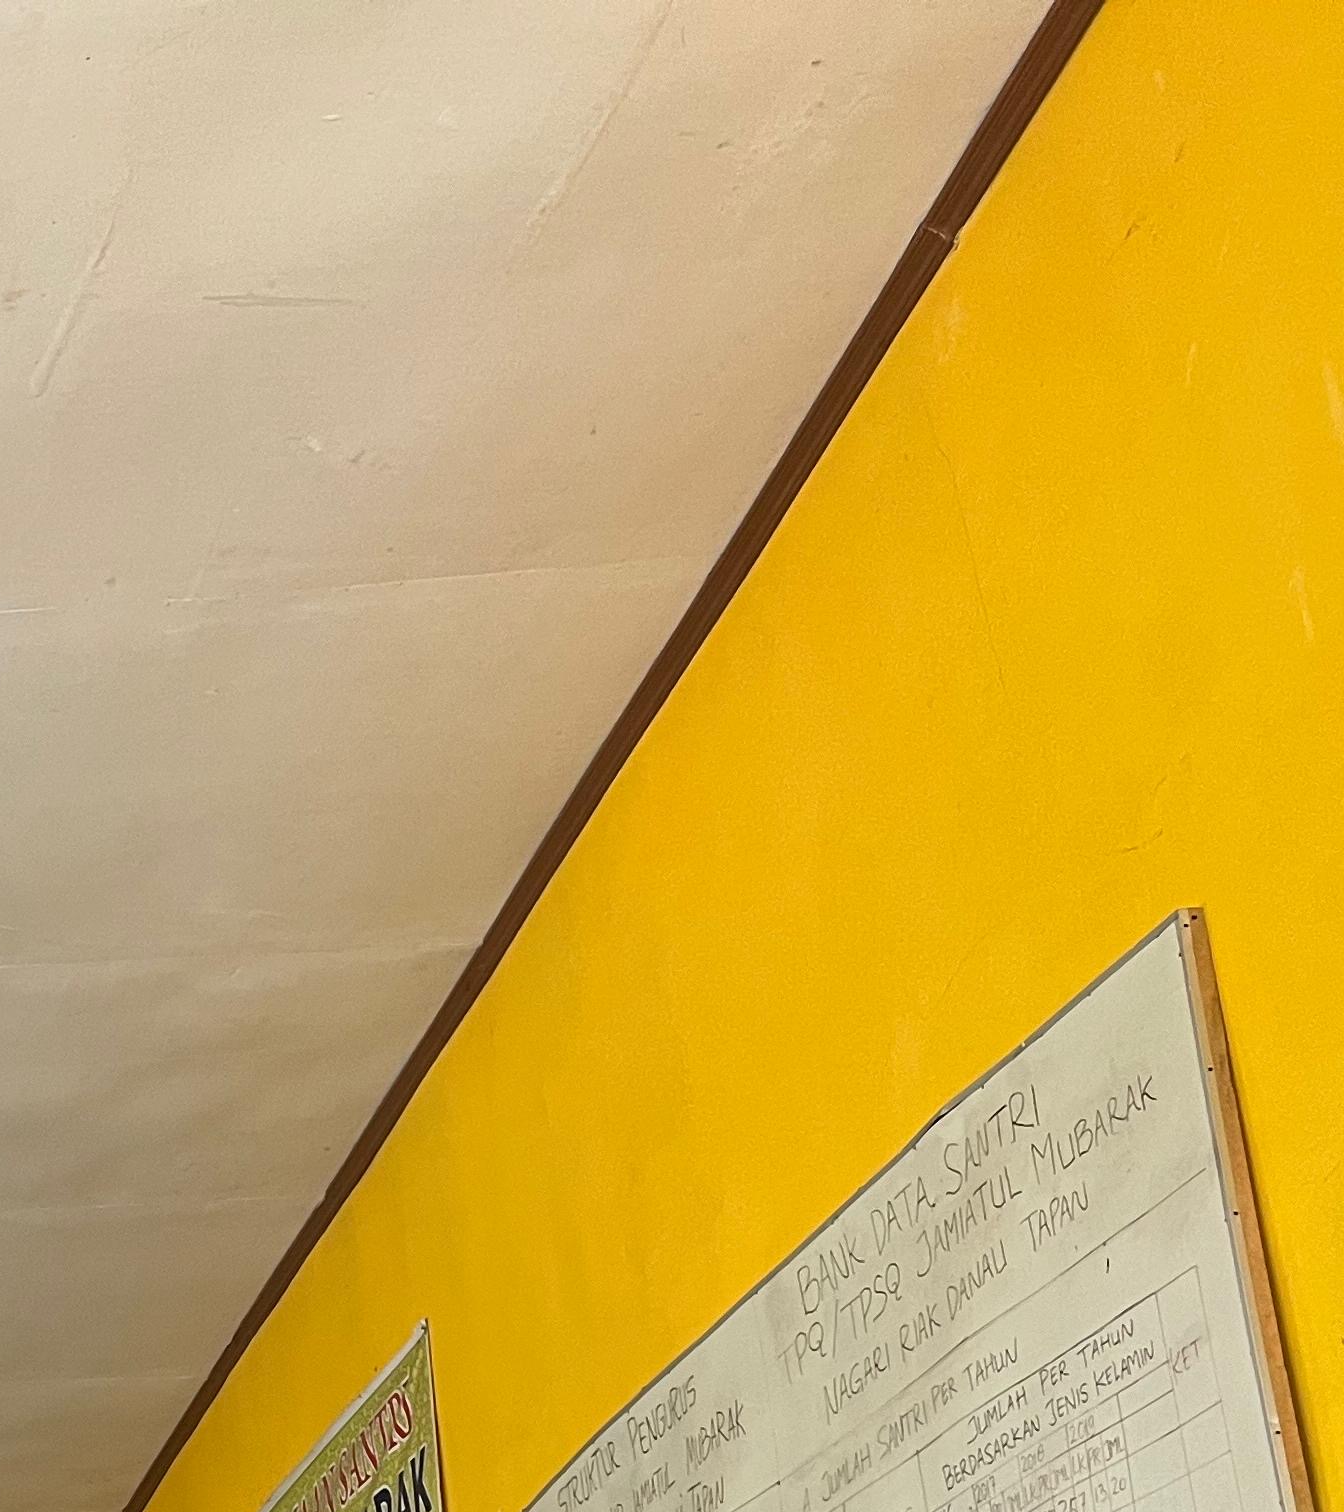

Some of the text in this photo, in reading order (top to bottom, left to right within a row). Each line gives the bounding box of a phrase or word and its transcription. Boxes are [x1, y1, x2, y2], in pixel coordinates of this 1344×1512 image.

[796, 1084, 1040, 1315] BANK DATA SANTRI
[916, 1166, 1023, 1278] JAMIATUL
[1031, 1075, 1157, 1184] MUBARAK
[823, 1181, 1089, 1424] NAGARI RIAK DANAU TAPAN
[627, 1374, 697, 1461] PENGURUS
[685, 1399, 746, 1475] MUBARAK
[821, 1336, 1018, 1502] JUMLAH SANTRI PER TAHUN
[941, 1340, 1156, 1492] BERDASARKAN JENIS KELAMIN
[967, 1388, 1027, 1444] JUMLAH
[1039, 1358, 1070, 1394] PER
[1077, 1318, 1134, 1363] TAHUN
[1171, 1336, 1203, 1378] KET
[1112, 1476, 1127, 1495] 20
